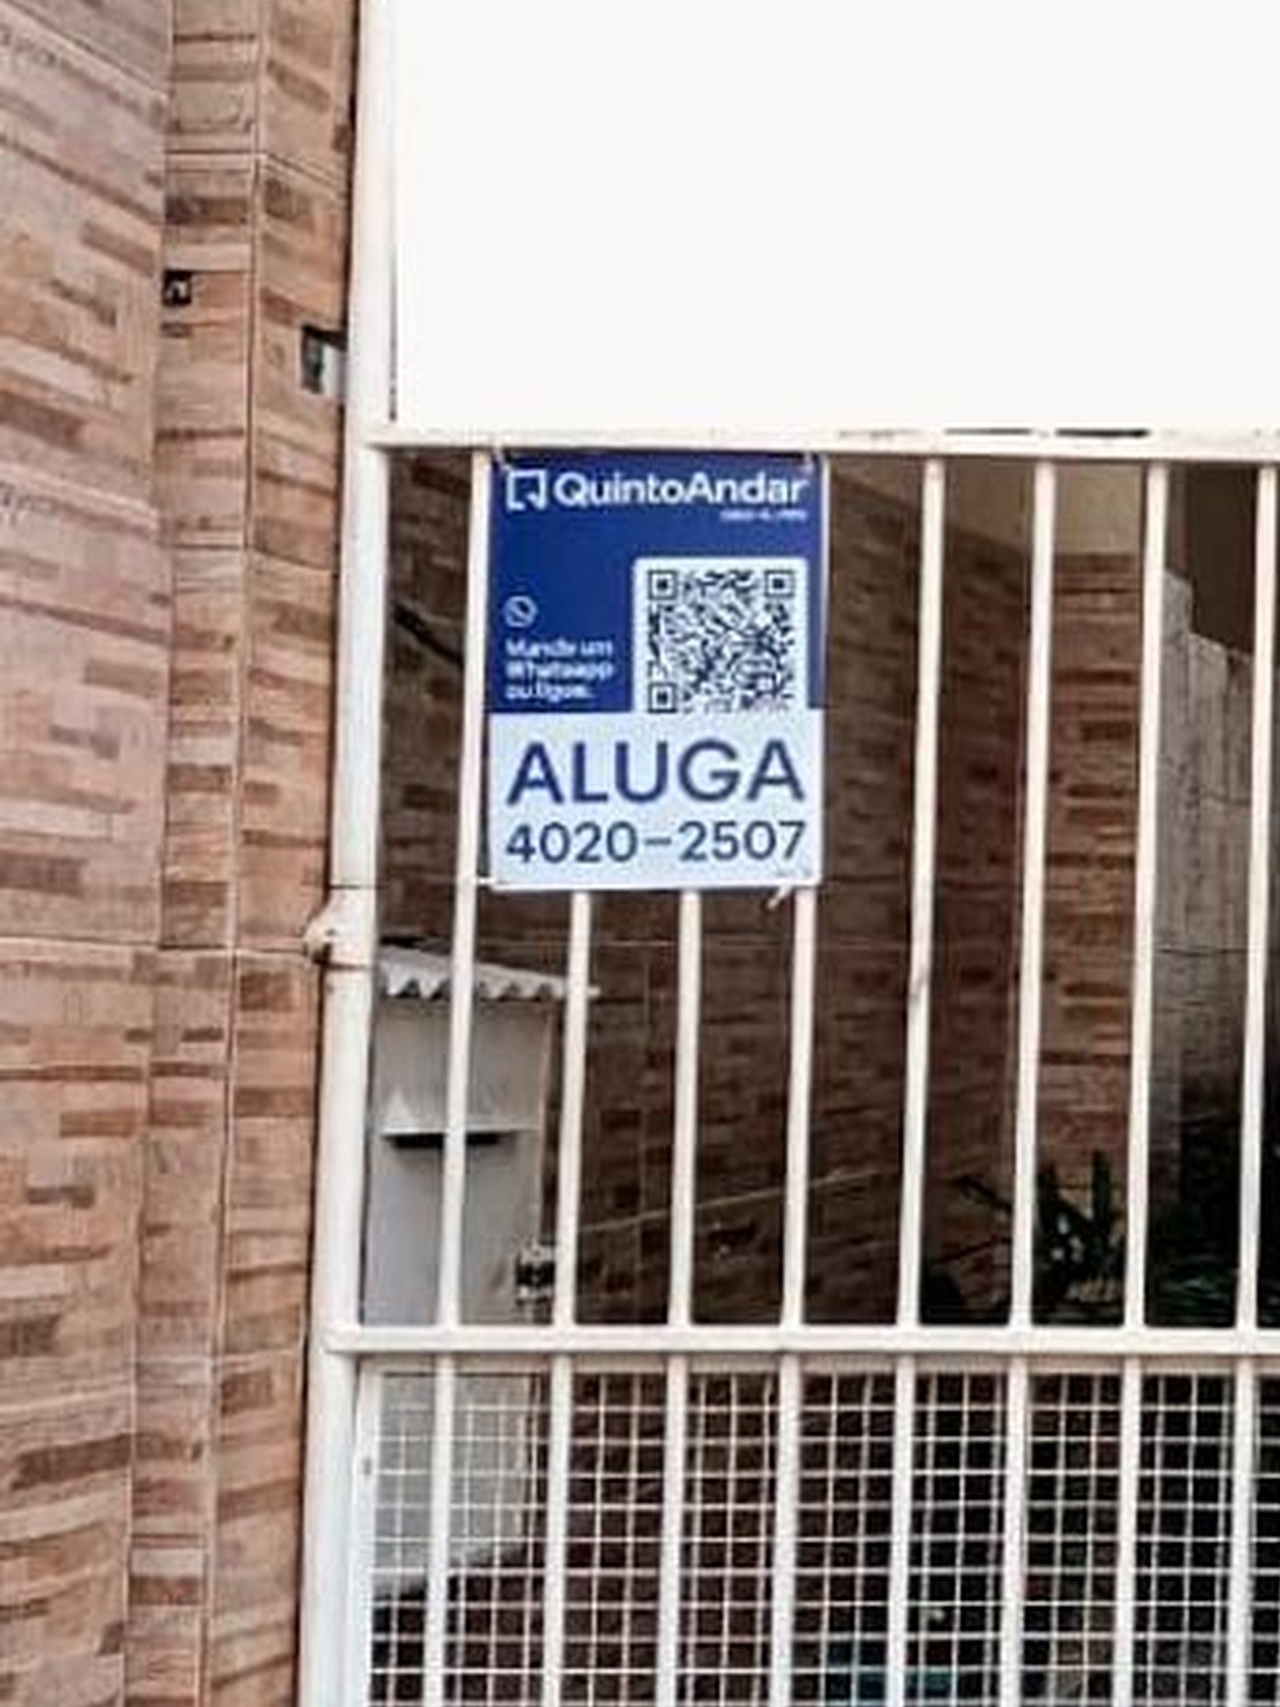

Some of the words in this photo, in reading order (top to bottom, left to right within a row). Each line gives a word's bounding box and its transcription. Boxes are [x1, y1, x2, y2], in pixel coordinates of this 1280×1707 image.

[554, 470, 810, 507] QuintoAndar
[506, 739, 806, 806] ALUGA
[506, 820, 807, 864] 4020-2507
